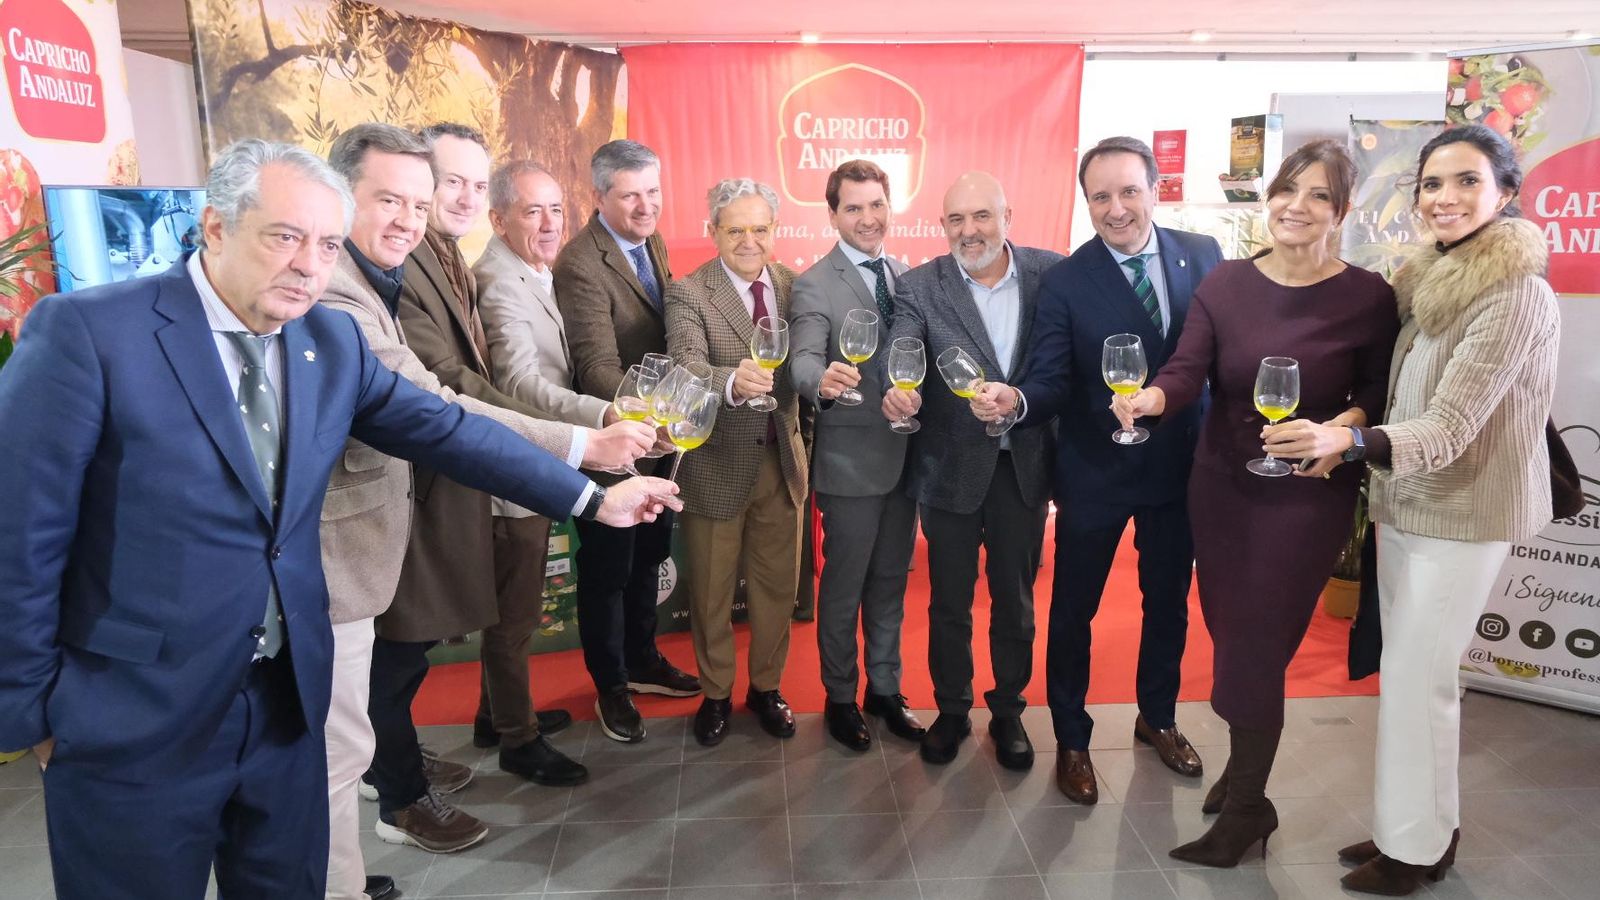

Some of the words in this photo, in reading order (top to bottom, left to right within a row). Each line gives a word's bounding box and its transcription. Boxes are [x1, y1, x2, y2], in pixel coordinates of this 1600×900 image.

[9, 27, 91, 75] CAPRICHO
[20, 65, 96, 107] ANDALUZ
[794, 112, 909, 139] CAPRICHO
